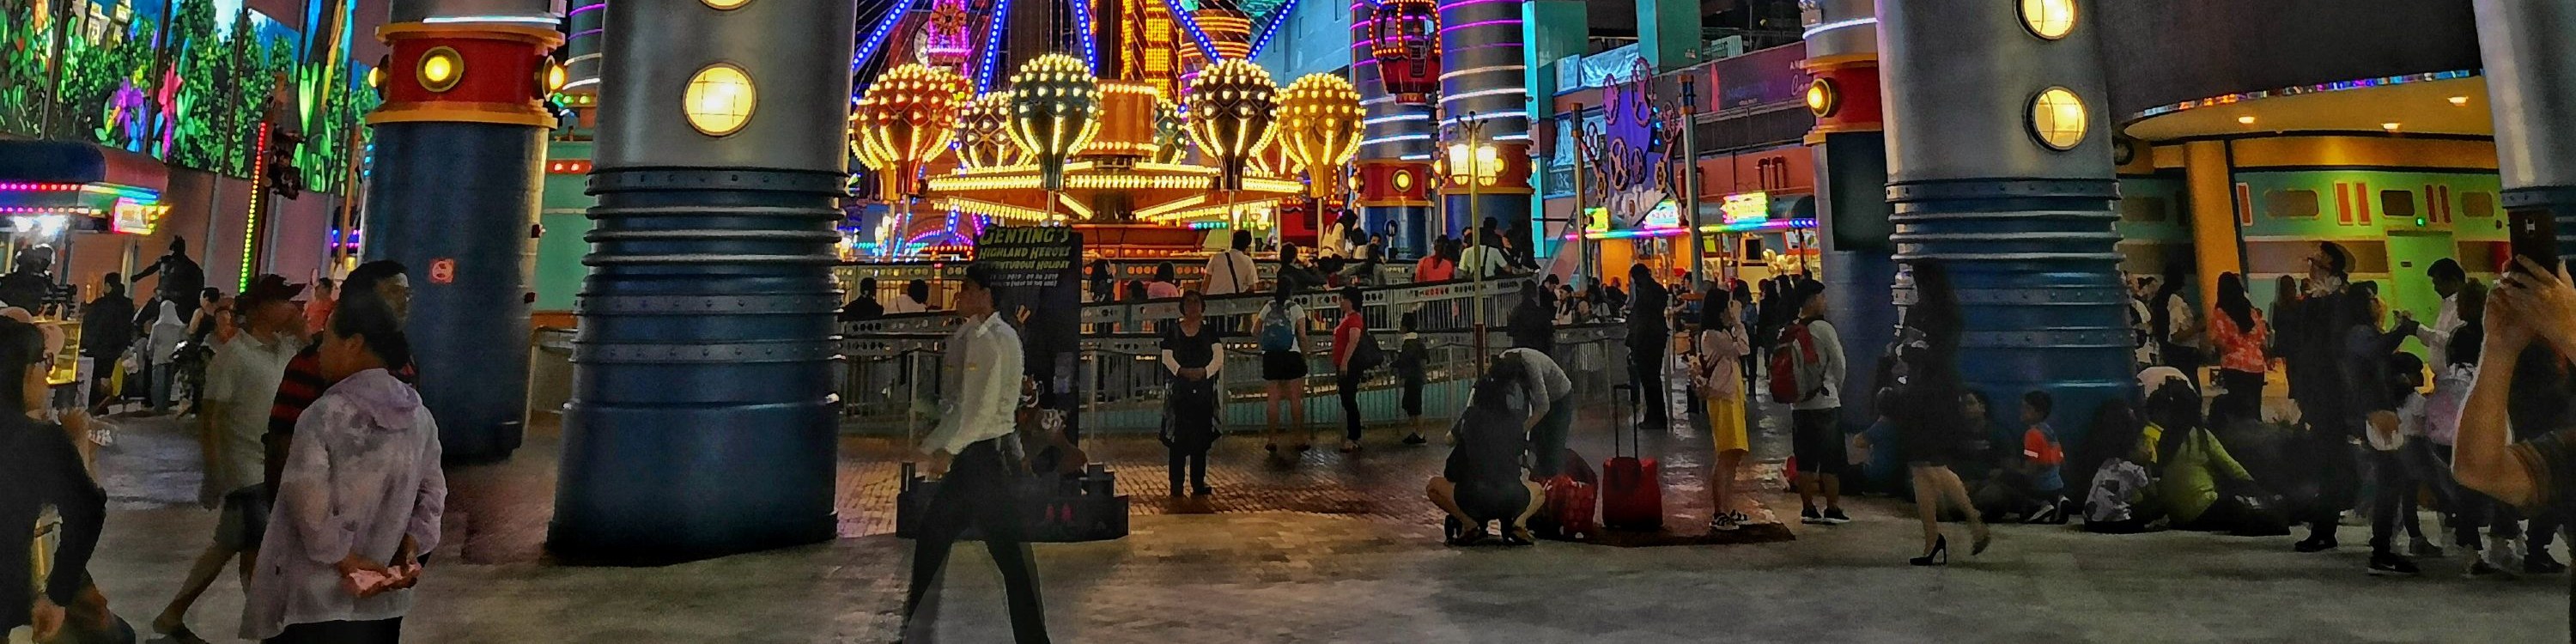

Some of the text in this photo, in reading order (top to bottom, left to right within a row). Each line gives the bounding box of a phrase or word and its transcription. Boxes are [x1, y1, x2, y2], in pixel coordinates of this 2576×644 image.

[979, 227, 1072, 246] GENTING'S
[978, 246, 1072, 260] HIGHLAND HEROES
[1036, 260, 1071, 270] HOLIDAY
